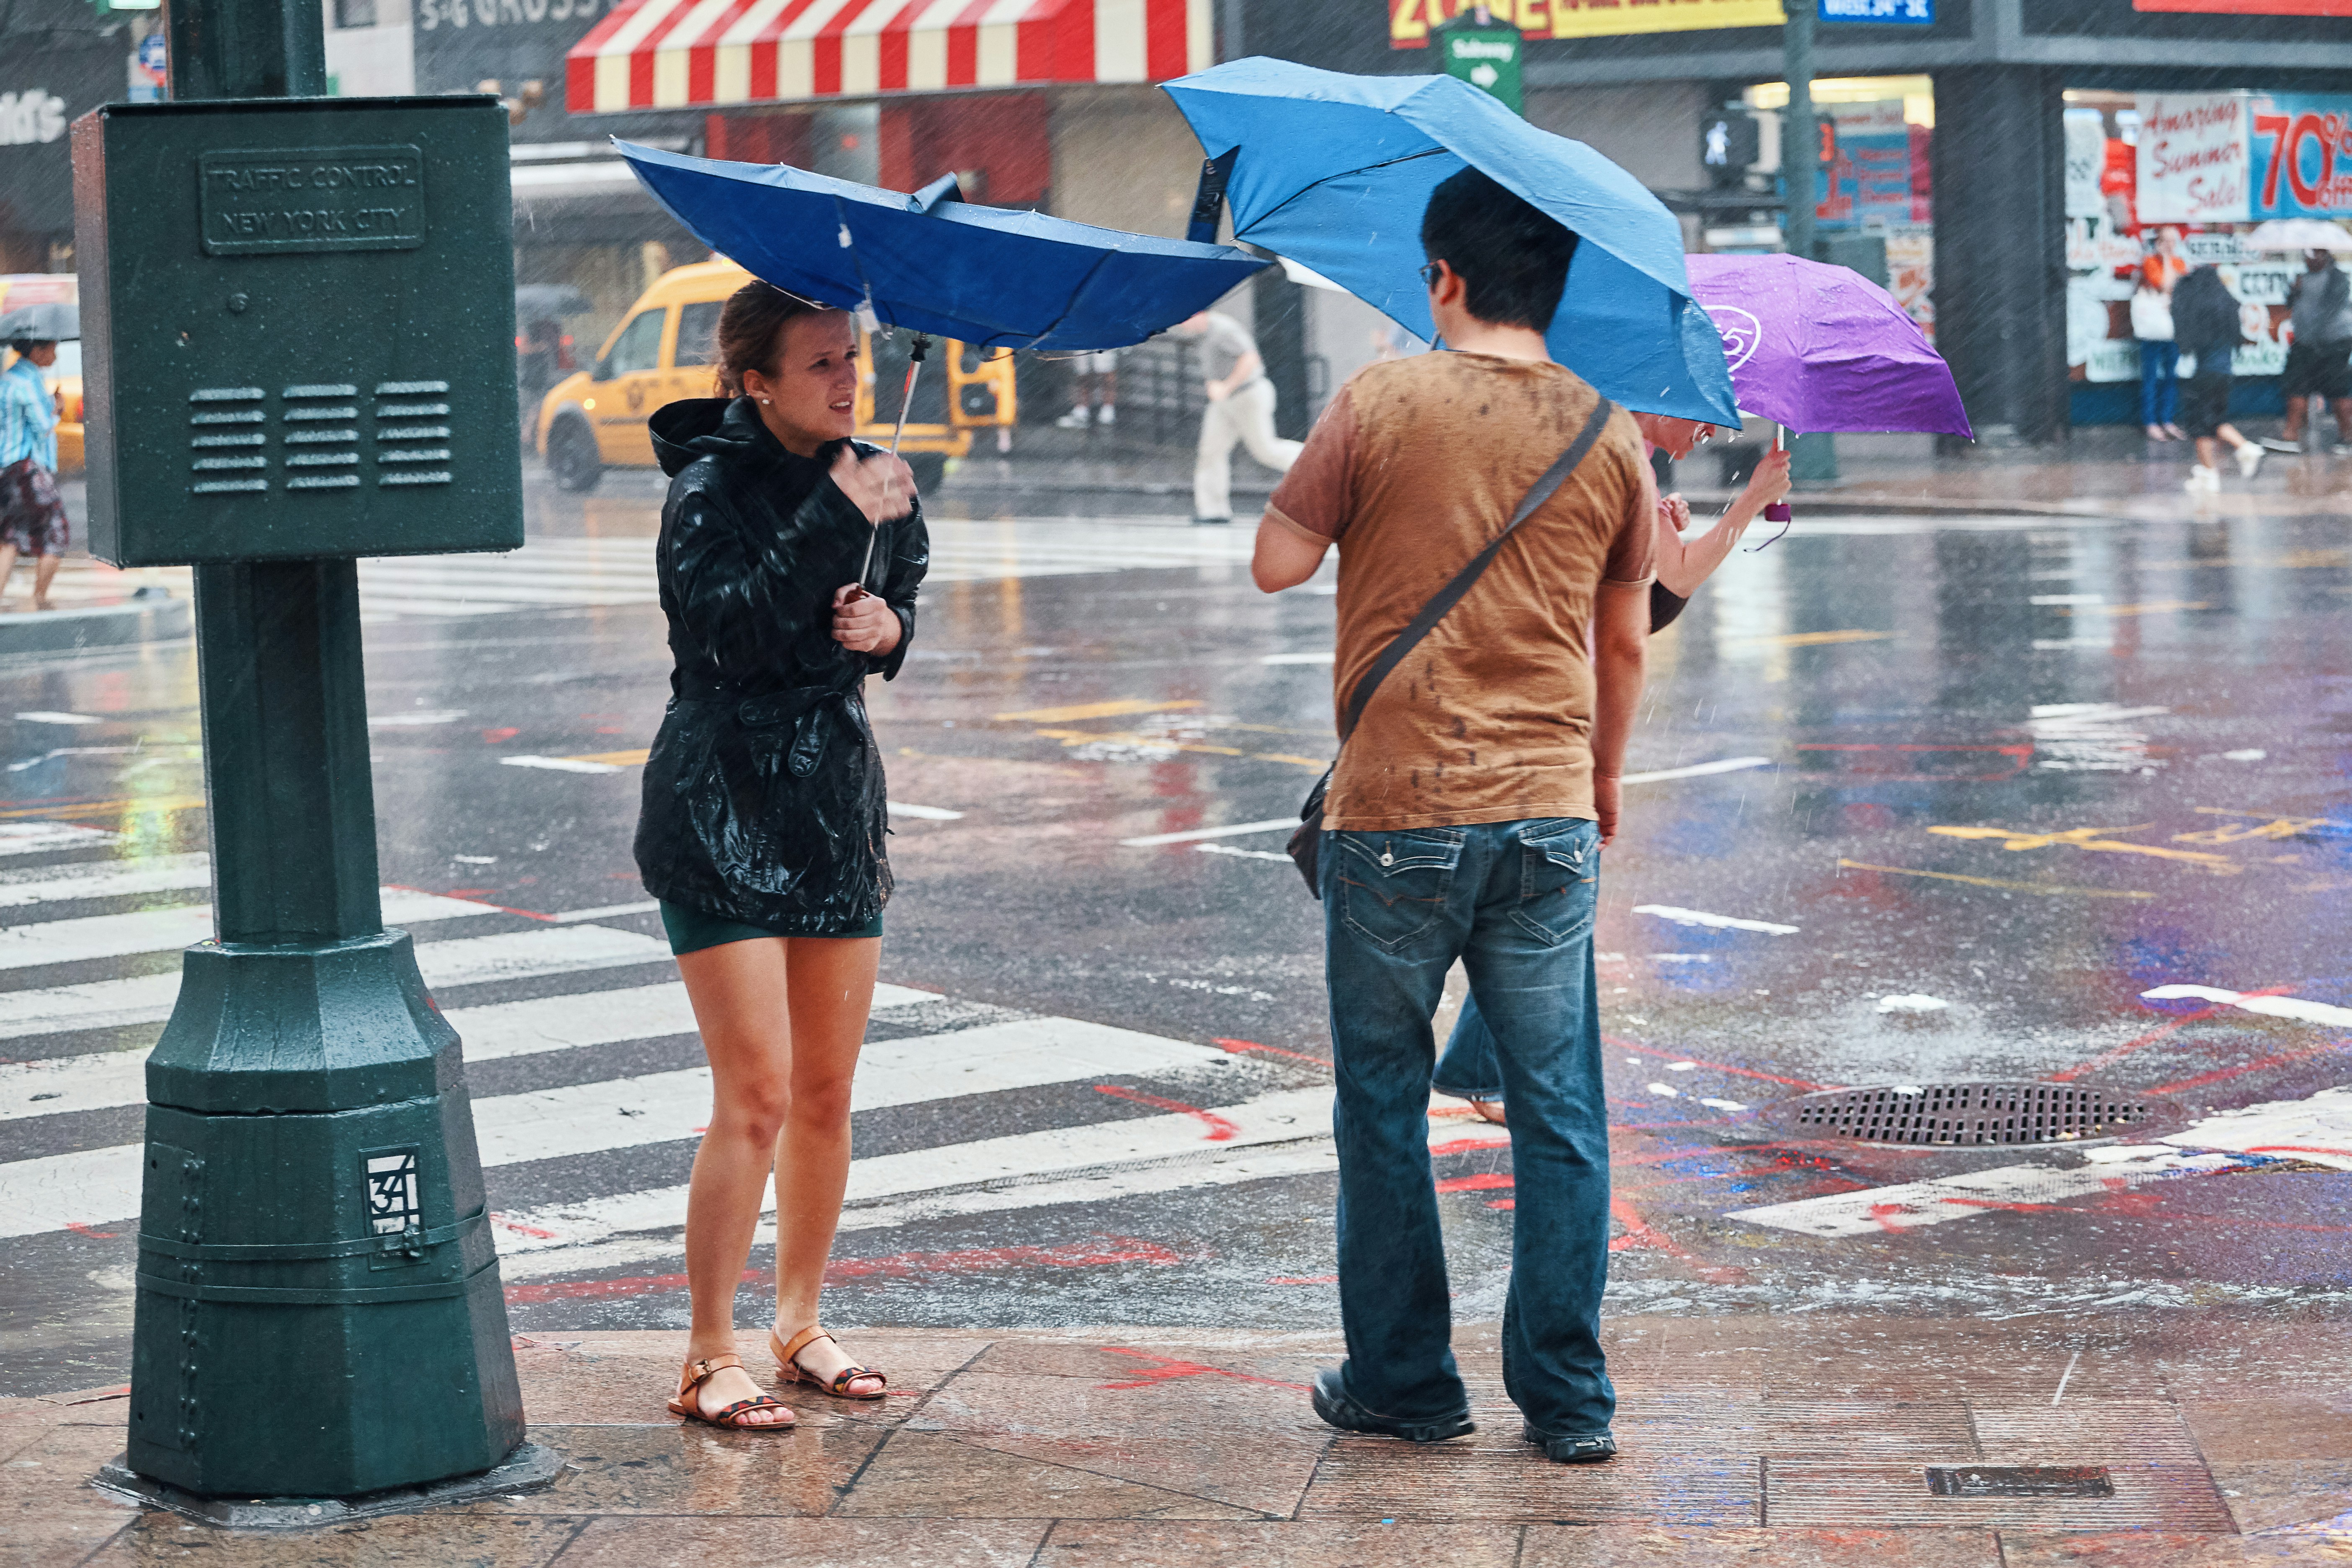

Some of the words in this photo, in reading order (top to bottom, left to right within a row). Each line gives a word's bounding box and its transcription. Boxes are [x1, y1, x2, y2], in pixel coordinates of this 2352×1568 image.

[1452, 38, 1515, 62] Subway
[2143, 99, 2238, 137] Amazing
[2152, 140, 2240, 179] Summer
[208, 168, 302, 190] TRAFFIC
[311, 166, 416, 188] CONTROL
[222, 211, 275, 233] NEW
[283, 209, 346, 231] YORK
[353, 208, 405, 229] CITY
